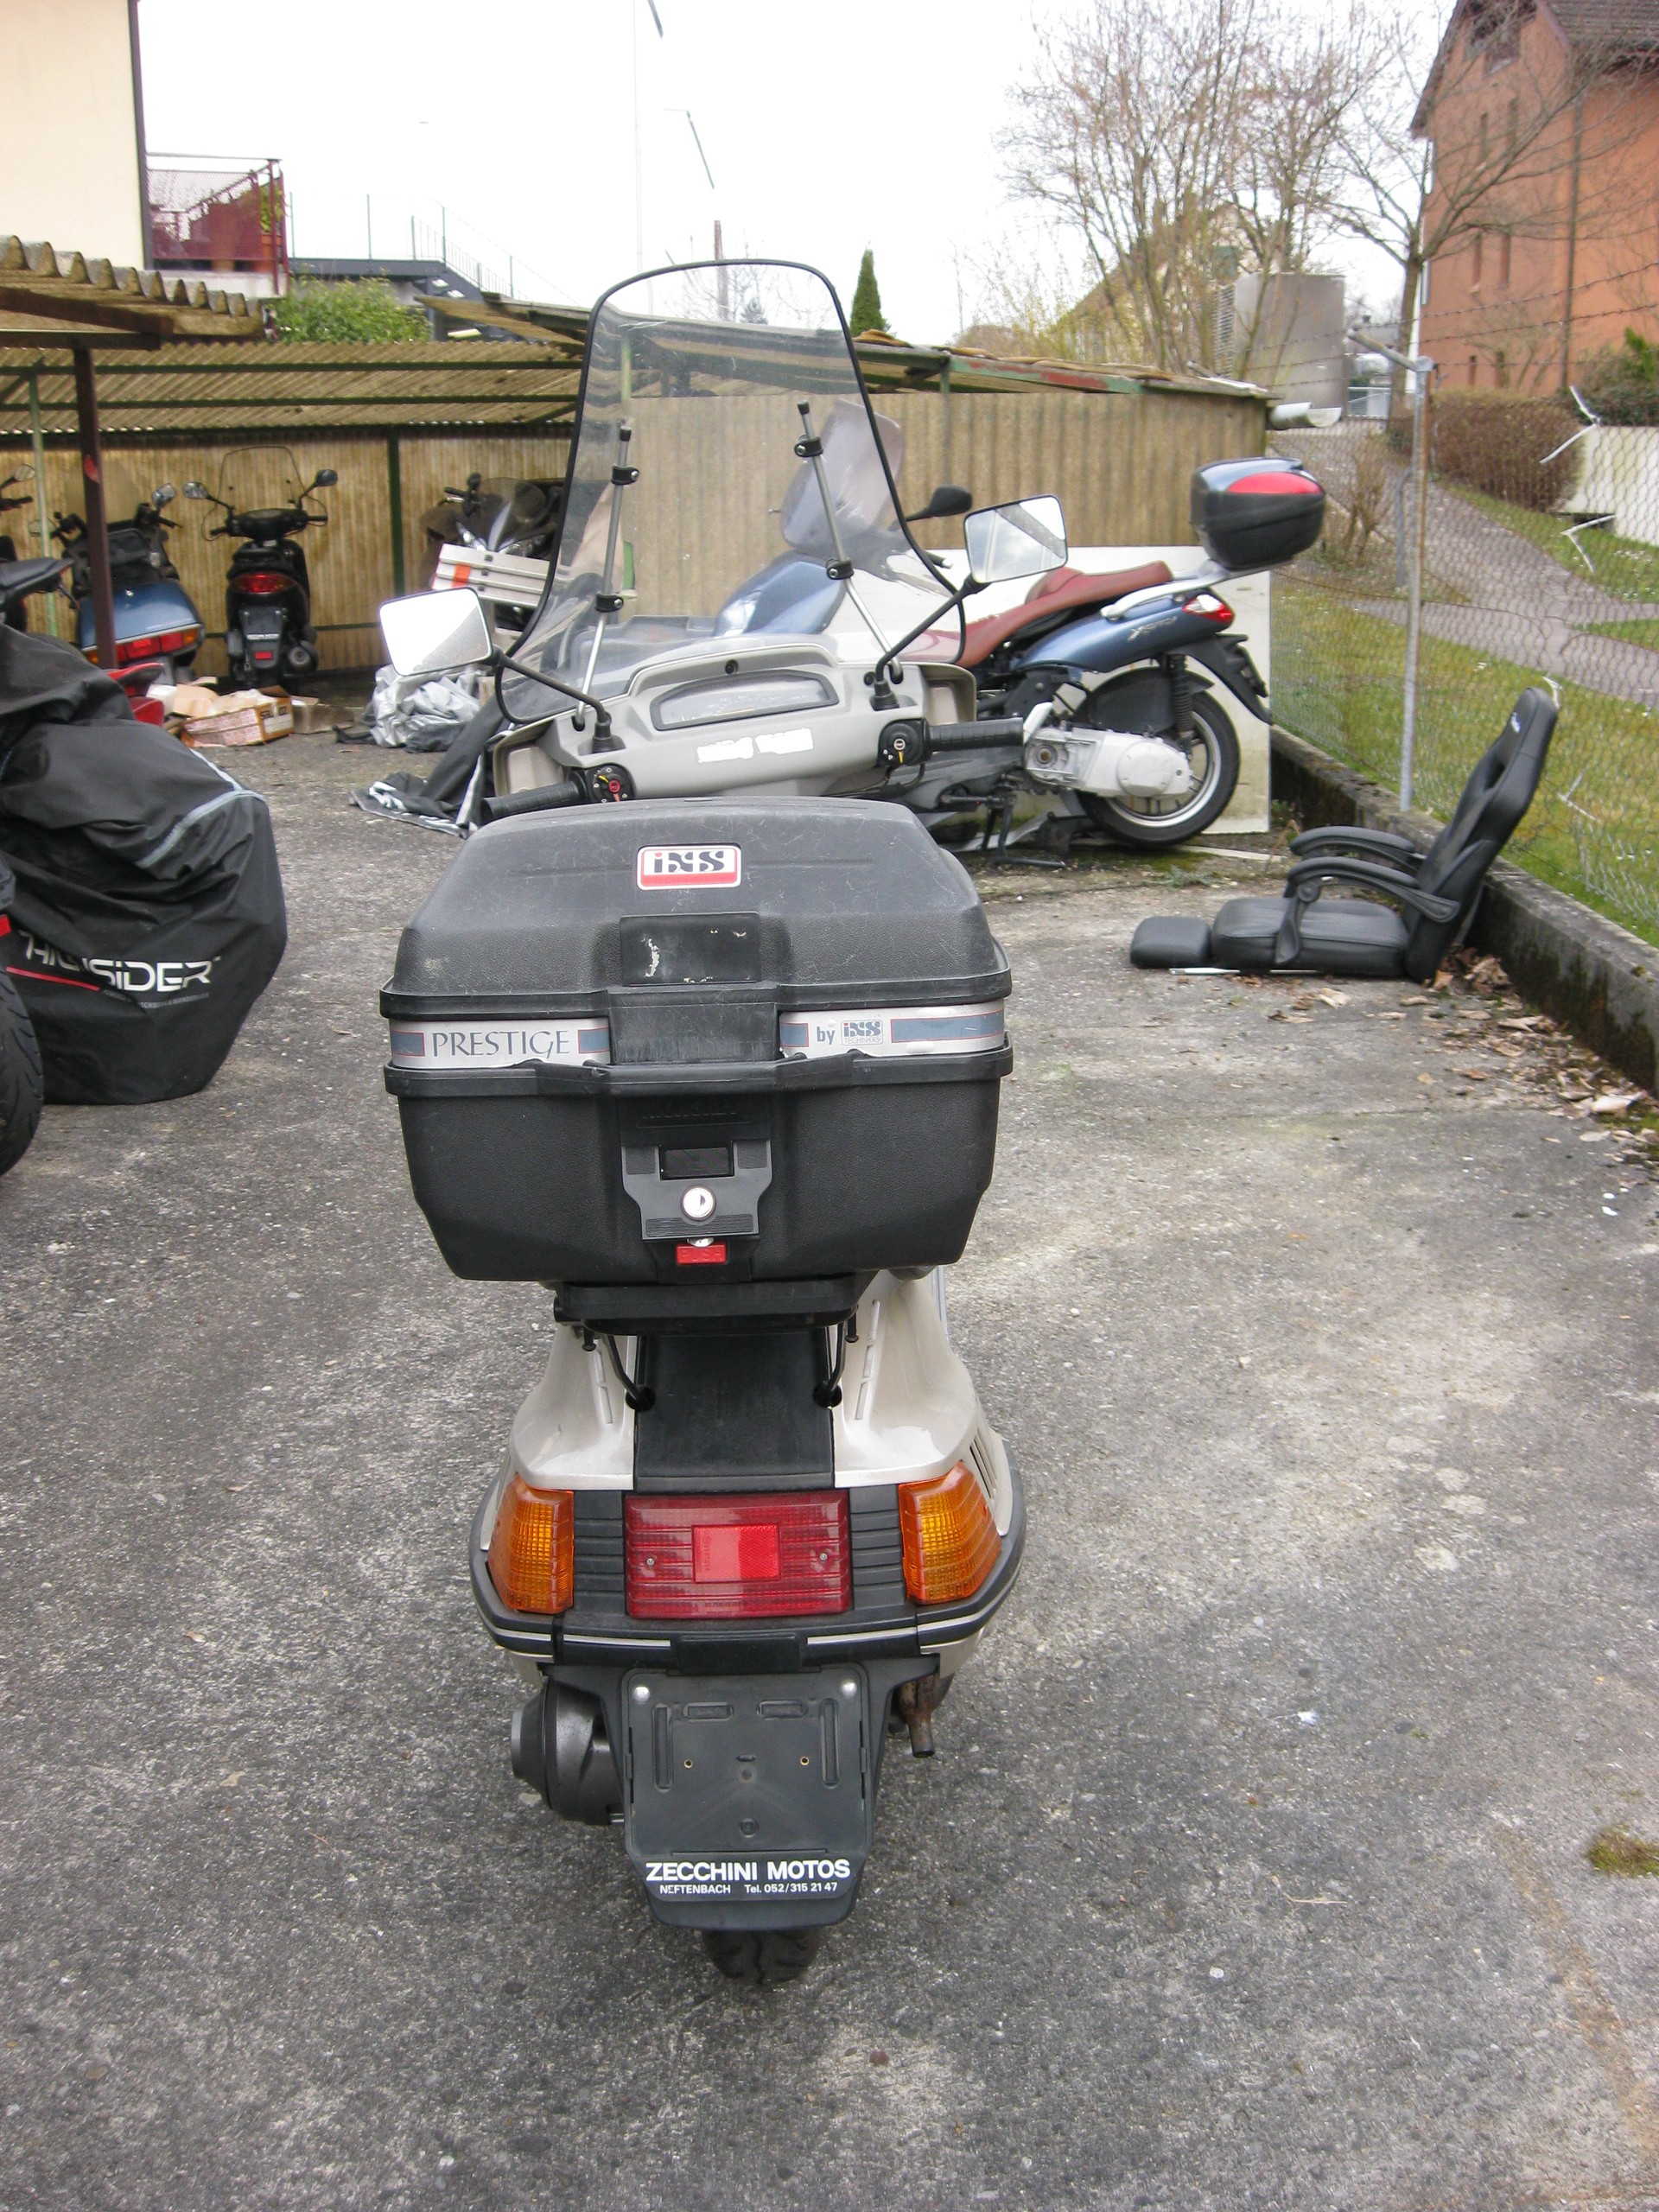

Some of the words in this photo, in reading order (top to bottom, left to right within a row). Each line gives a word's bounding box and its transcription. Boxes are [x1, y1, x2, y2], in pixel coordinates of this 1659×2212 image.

[431, 1030, 570, 1059] PRESTIGE
[816, 1026, 836, 1045] by
[680, 1247, 723, 1262] PUSH
[645, 1861, 758, 1882] ZECCHINI
[766, 1859, 851, 1880] MOTOS
[659, 1884, 731, 1895] NEFTENBACH
[744, 1884, 762, 1894] Tel.
[763, 1882, 809, 1894] 052/315
[810, 1882, 823, 1892] 21
[823, 1881, 838, 1892] 47
